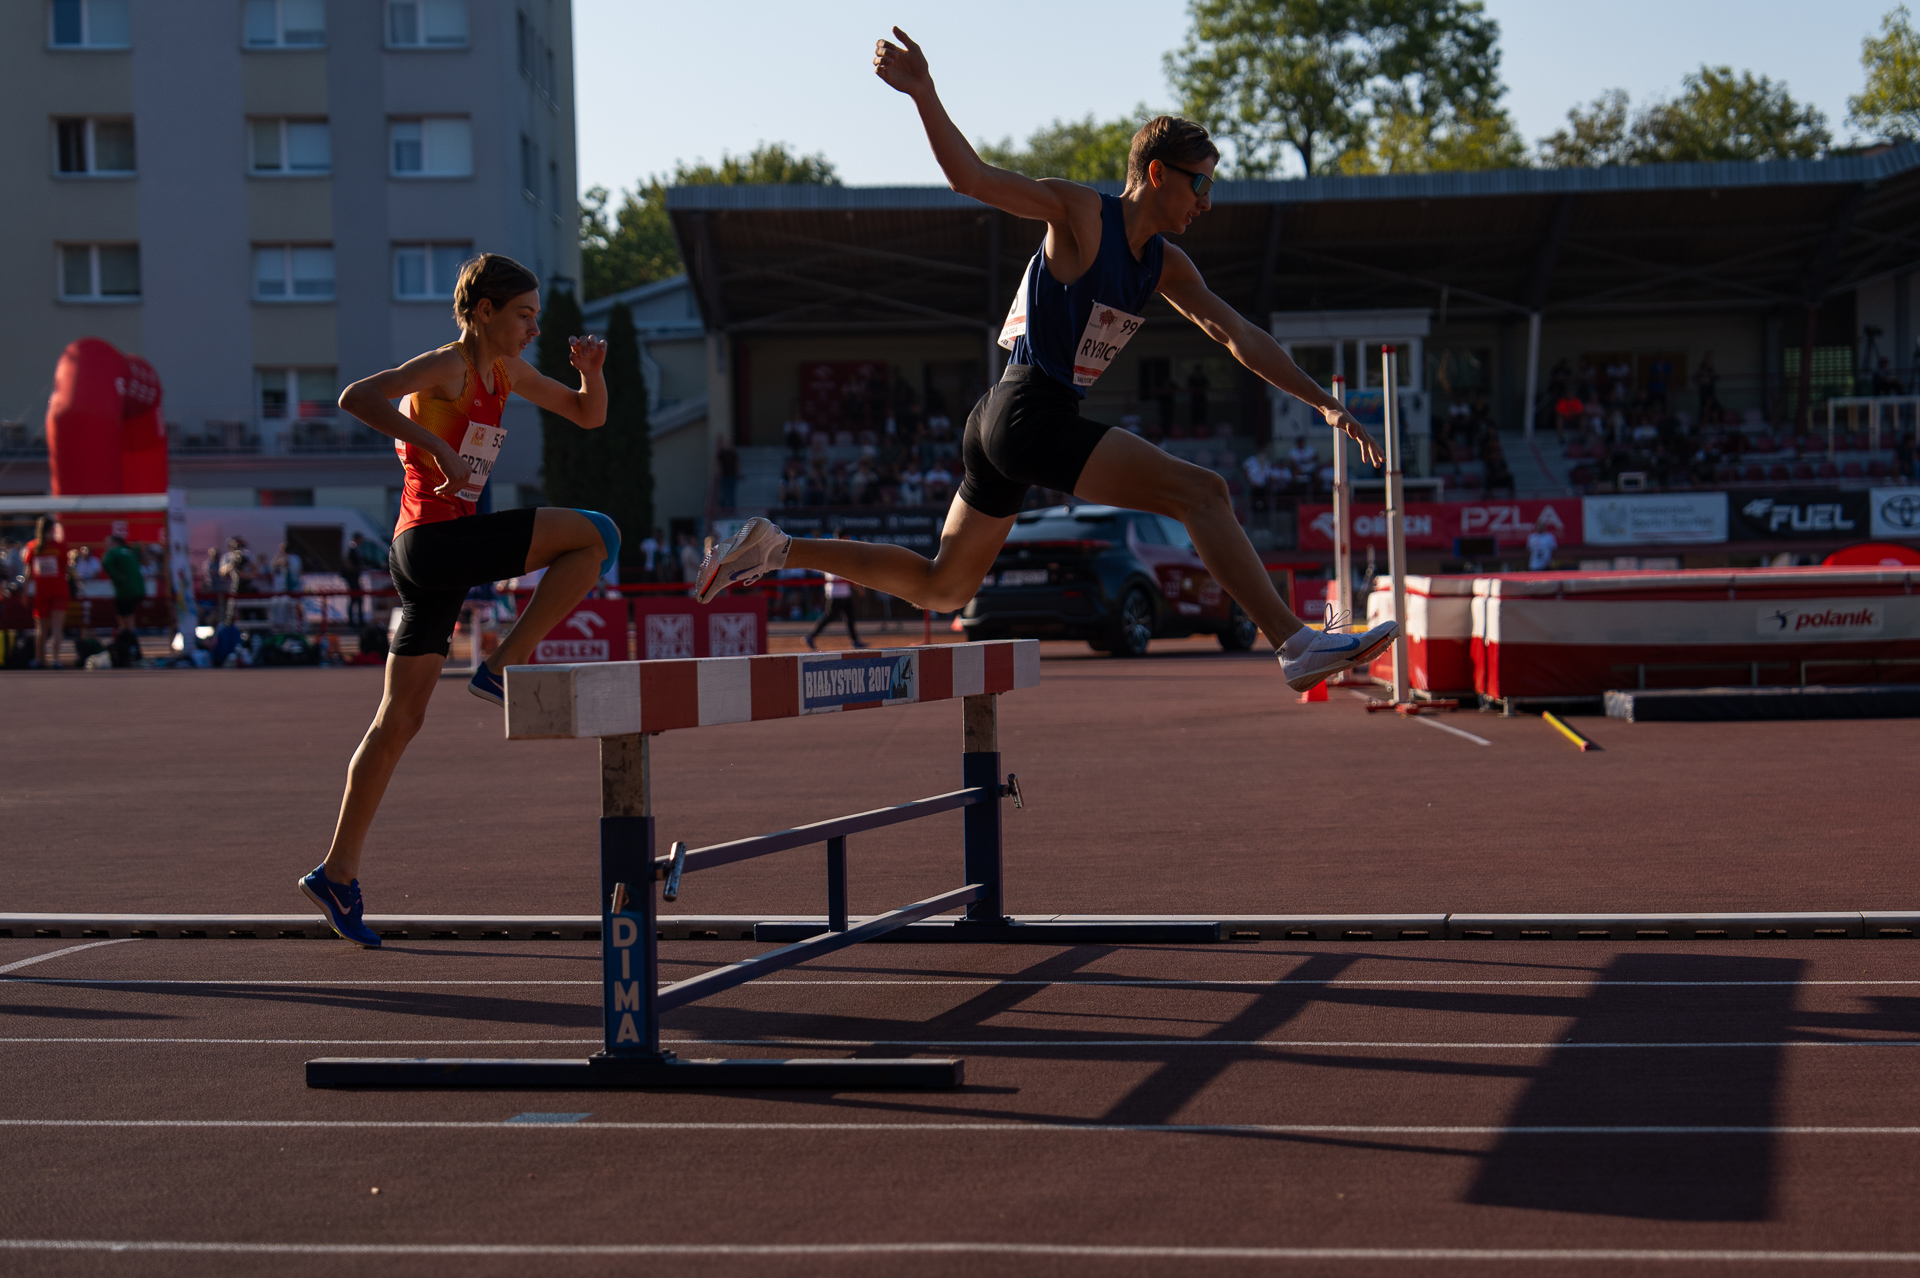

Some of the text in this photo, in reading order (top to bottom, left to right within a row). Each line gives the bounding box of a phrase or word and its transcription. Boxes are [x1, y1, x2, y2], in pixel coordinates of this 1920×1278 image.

[1120, 319, 1139, 336] 99
[1080, 338, 1121, 361] RYBIC
[1353, 514, 1433, 536] OREN
[1460, 505, 1565, 533] PZLA
[1769, 503, 1856, 532] FUEL
[1795, 608, 1875, 632] polanik
[541, 641, 604, 658] ORLEN
[804, 665, 891, 699] BIAŁYSTOK 2017
[611, 916, 641, 1044] DIMA
